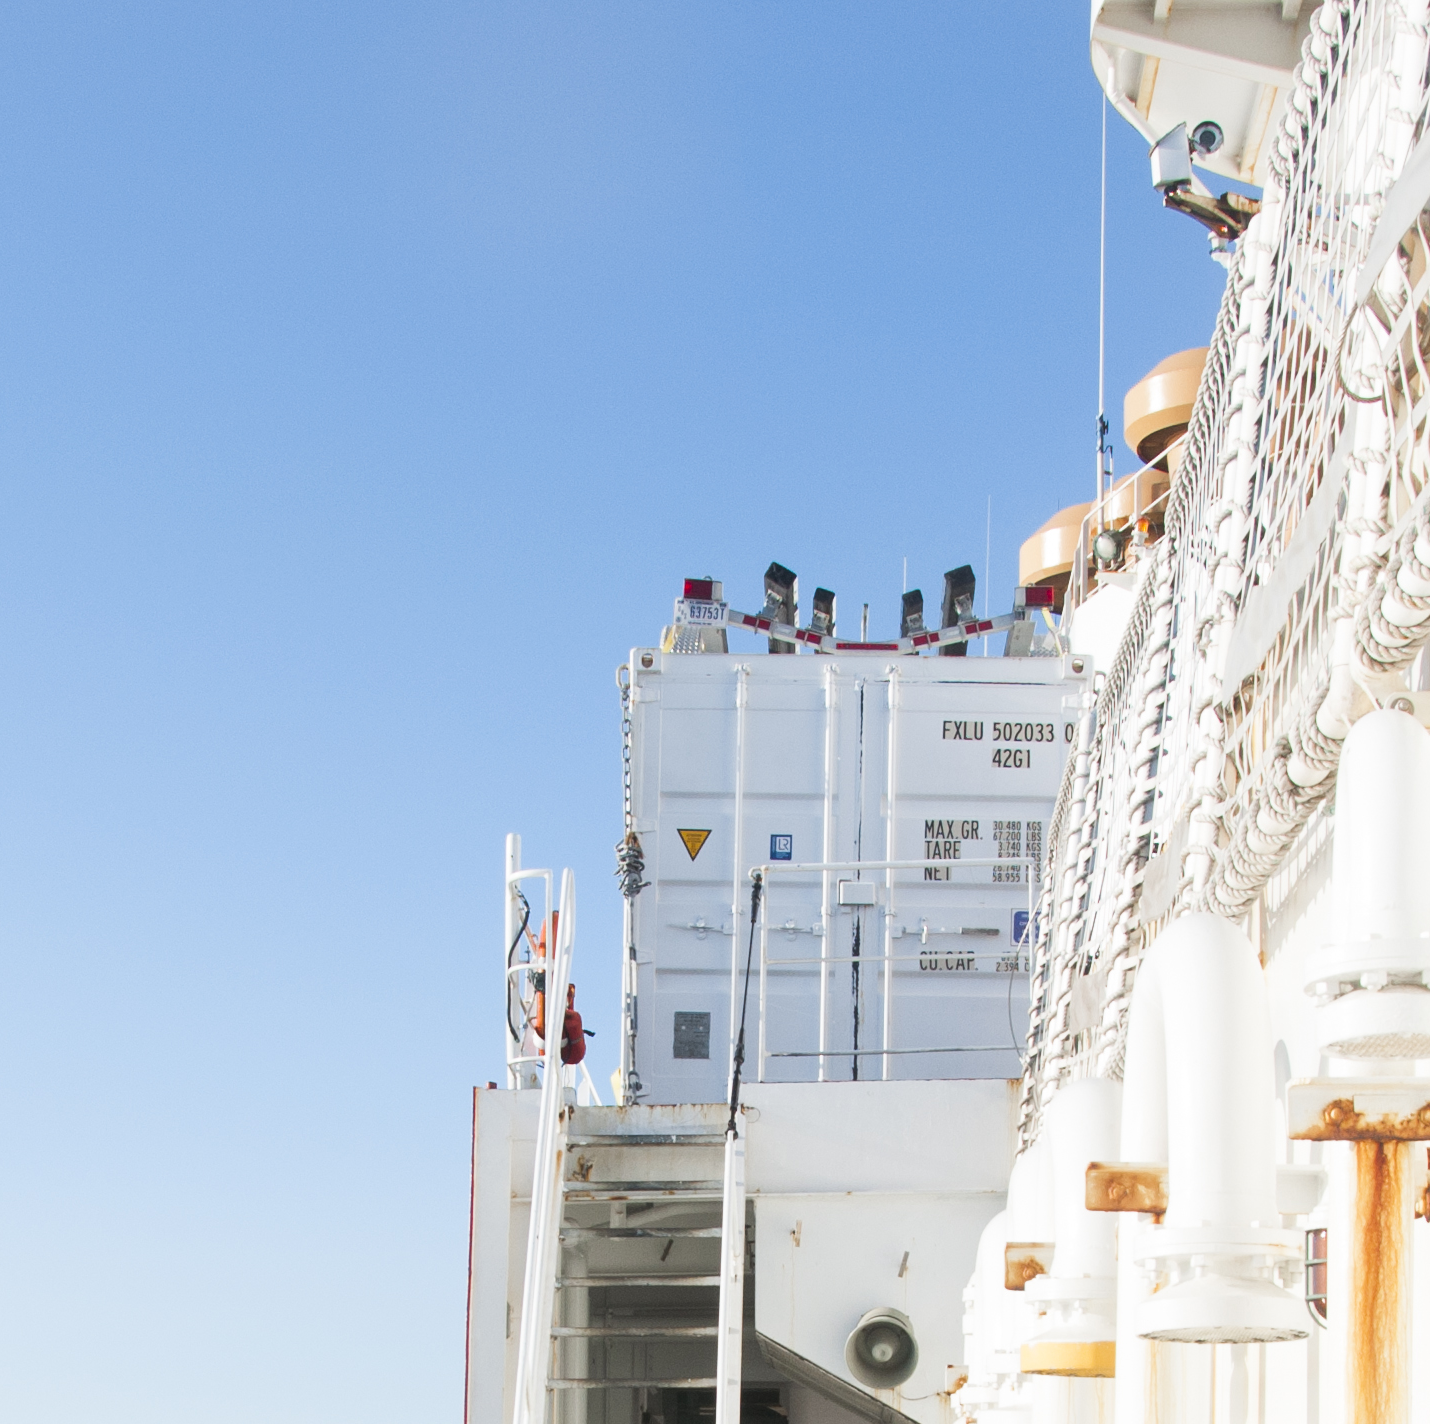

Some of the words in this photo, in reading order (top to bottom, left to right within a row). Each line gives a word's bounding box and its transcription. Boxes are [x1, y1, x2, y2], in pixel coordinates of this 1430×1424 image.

[942, 720, 984, 741] FXLU
[992, 722, 1055, 743] 502033
[992, 749, 1031, 768] 42G1
[993, 821, 1022, 831] 30.480
[1026, 821, 1042, 832] KGS
[993, 831, 1022, 841] 67.200
[1026, 832, 1042, 842] LBS
[924, 840, 961, 859] TARE
[998, 841, 1021, 851] 3.740
[1026, 842, 1042, 852] KGS
[992, 872, 1021, 883] 58.955
[1025, 873, 1041, 883] LS
